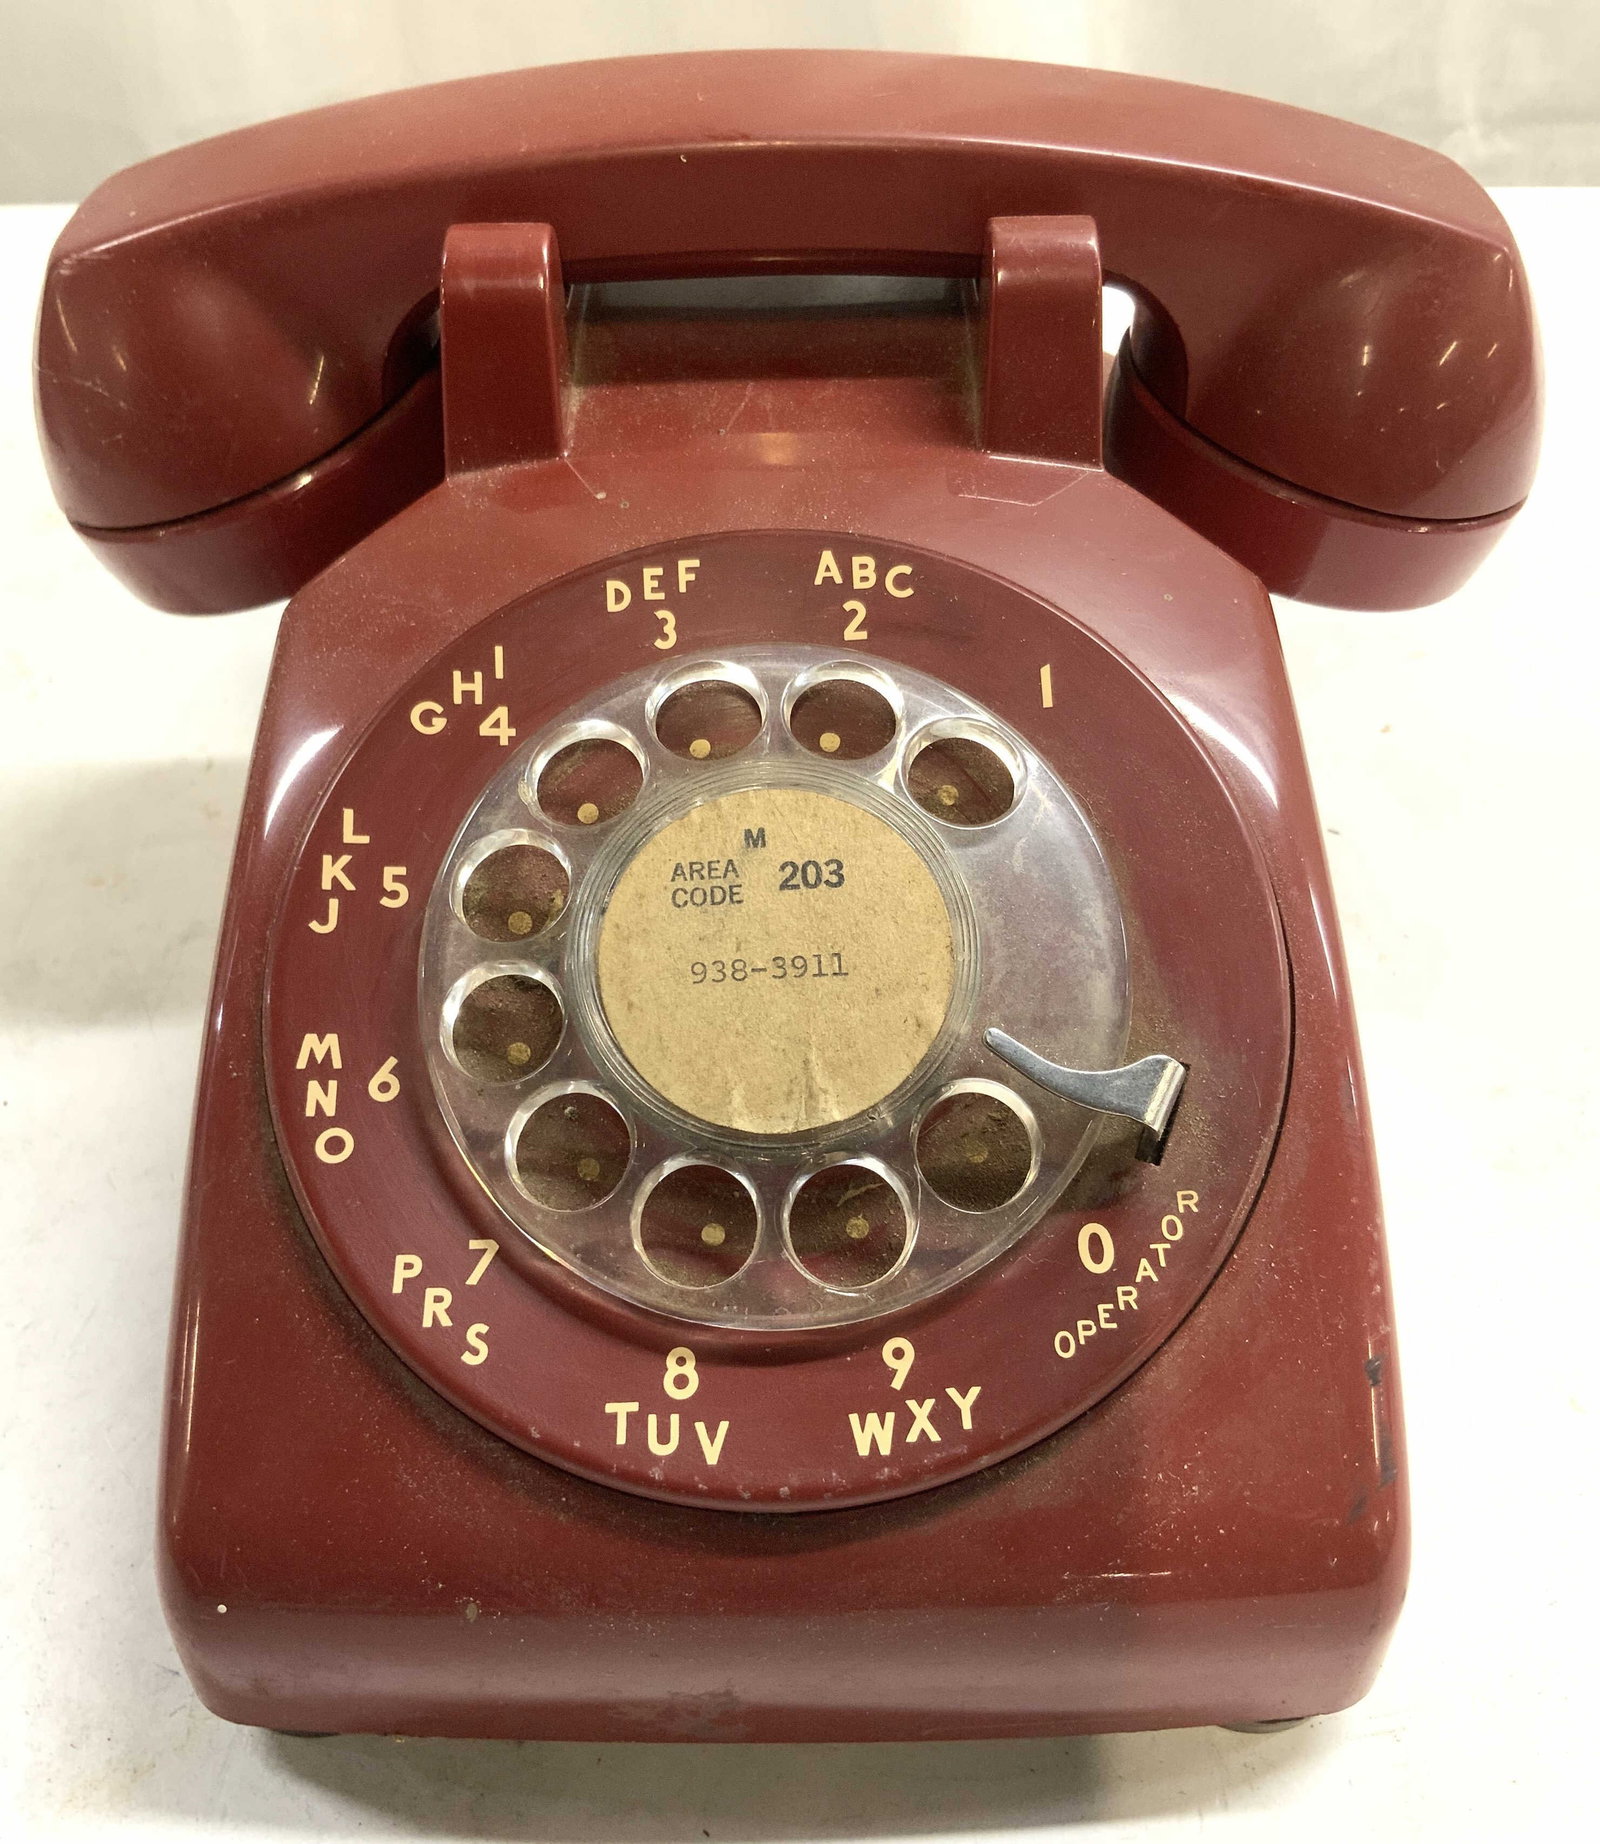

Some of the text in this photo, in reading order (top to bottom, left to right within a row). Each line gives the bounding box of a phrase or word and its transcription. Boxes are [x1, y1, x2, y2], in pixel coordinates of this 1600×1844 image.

[606, 559, 701, 613] DEF
[813, 550, 915, 598] ABC
[653, 609, 678, 650] 3
[842, 599, 868, 641] 2
[479, 705, 517, 746] 4
[743, 827, 767, 848] M
[379, 866, 409, 909] 5
[670, 859, 740, 882] AREA
[778, 859, 846, 891] 203
[671, 884, 744, 908] CODE
[690, 952, 849, 984] 938-3911
[367, 1055, 401, 1103] 6
[465, 1239, 500, 1286] 7
[1054, 1190, 1199, 1359] OPERATOR
[662, 1346, 700, 1401] 8
[881, 1336, 915, 1391] 9
[604, 1401, 730, 1466] TUV
[848, 1386, 982, 1457] WXY
